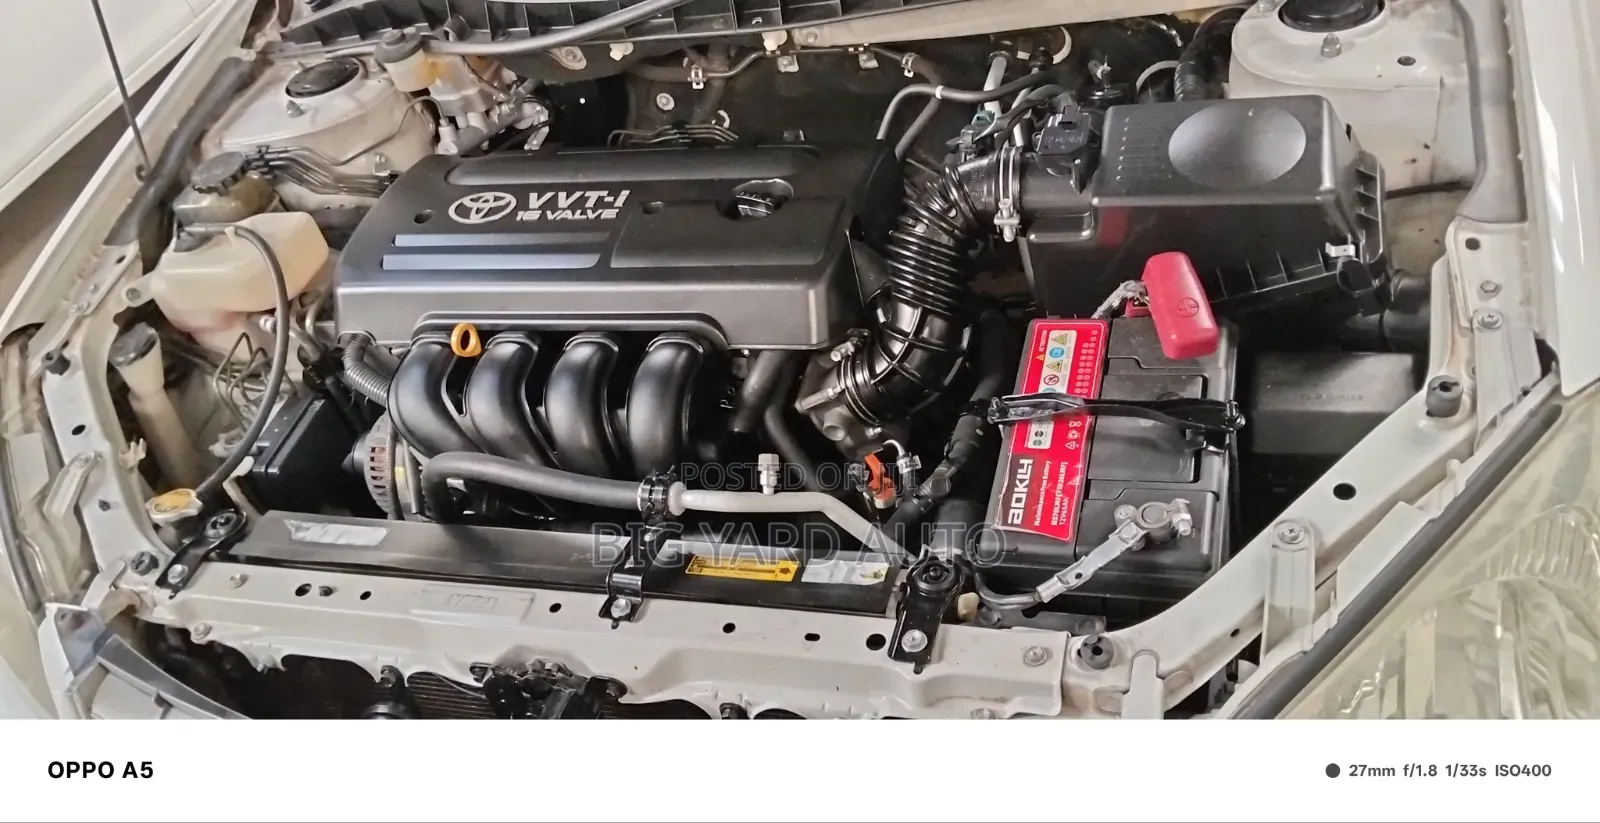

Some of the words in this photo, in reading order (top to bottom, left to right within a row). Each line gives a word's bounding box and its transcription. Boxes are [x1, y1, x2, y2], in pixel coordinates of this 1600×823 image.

[516, 210, 542, 221] 16
[547, 209, 620, 220] VALVE
[1042, 460, 1052, 479] Battery
